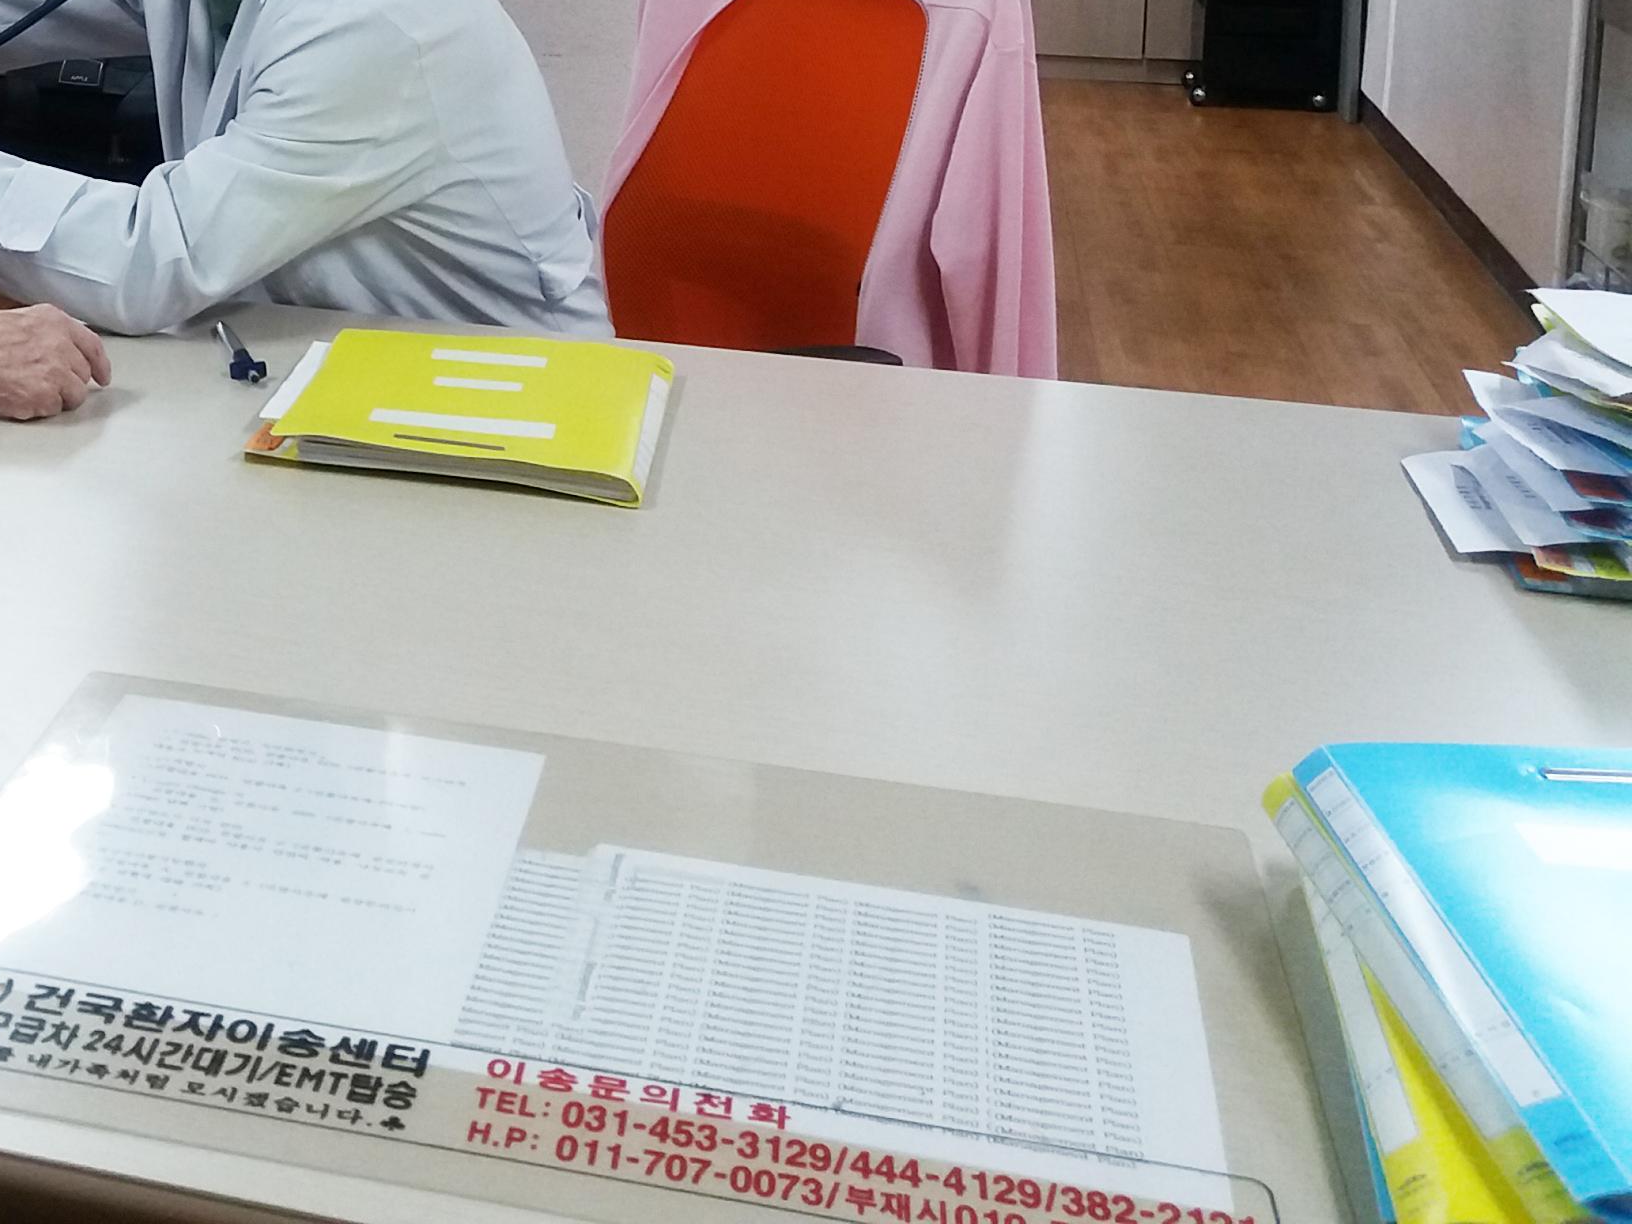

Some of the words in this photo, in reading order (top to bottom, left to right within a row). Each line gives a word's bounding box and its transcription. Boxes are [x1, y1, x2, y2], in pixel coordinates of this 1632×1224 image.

[24, 982, 430, 1078] 건국환자이송센터
[475, 1087, 552, 1118] TEL:
[560, 1101, 1255, 1224] 031-453-3129/444-4129/382-21
